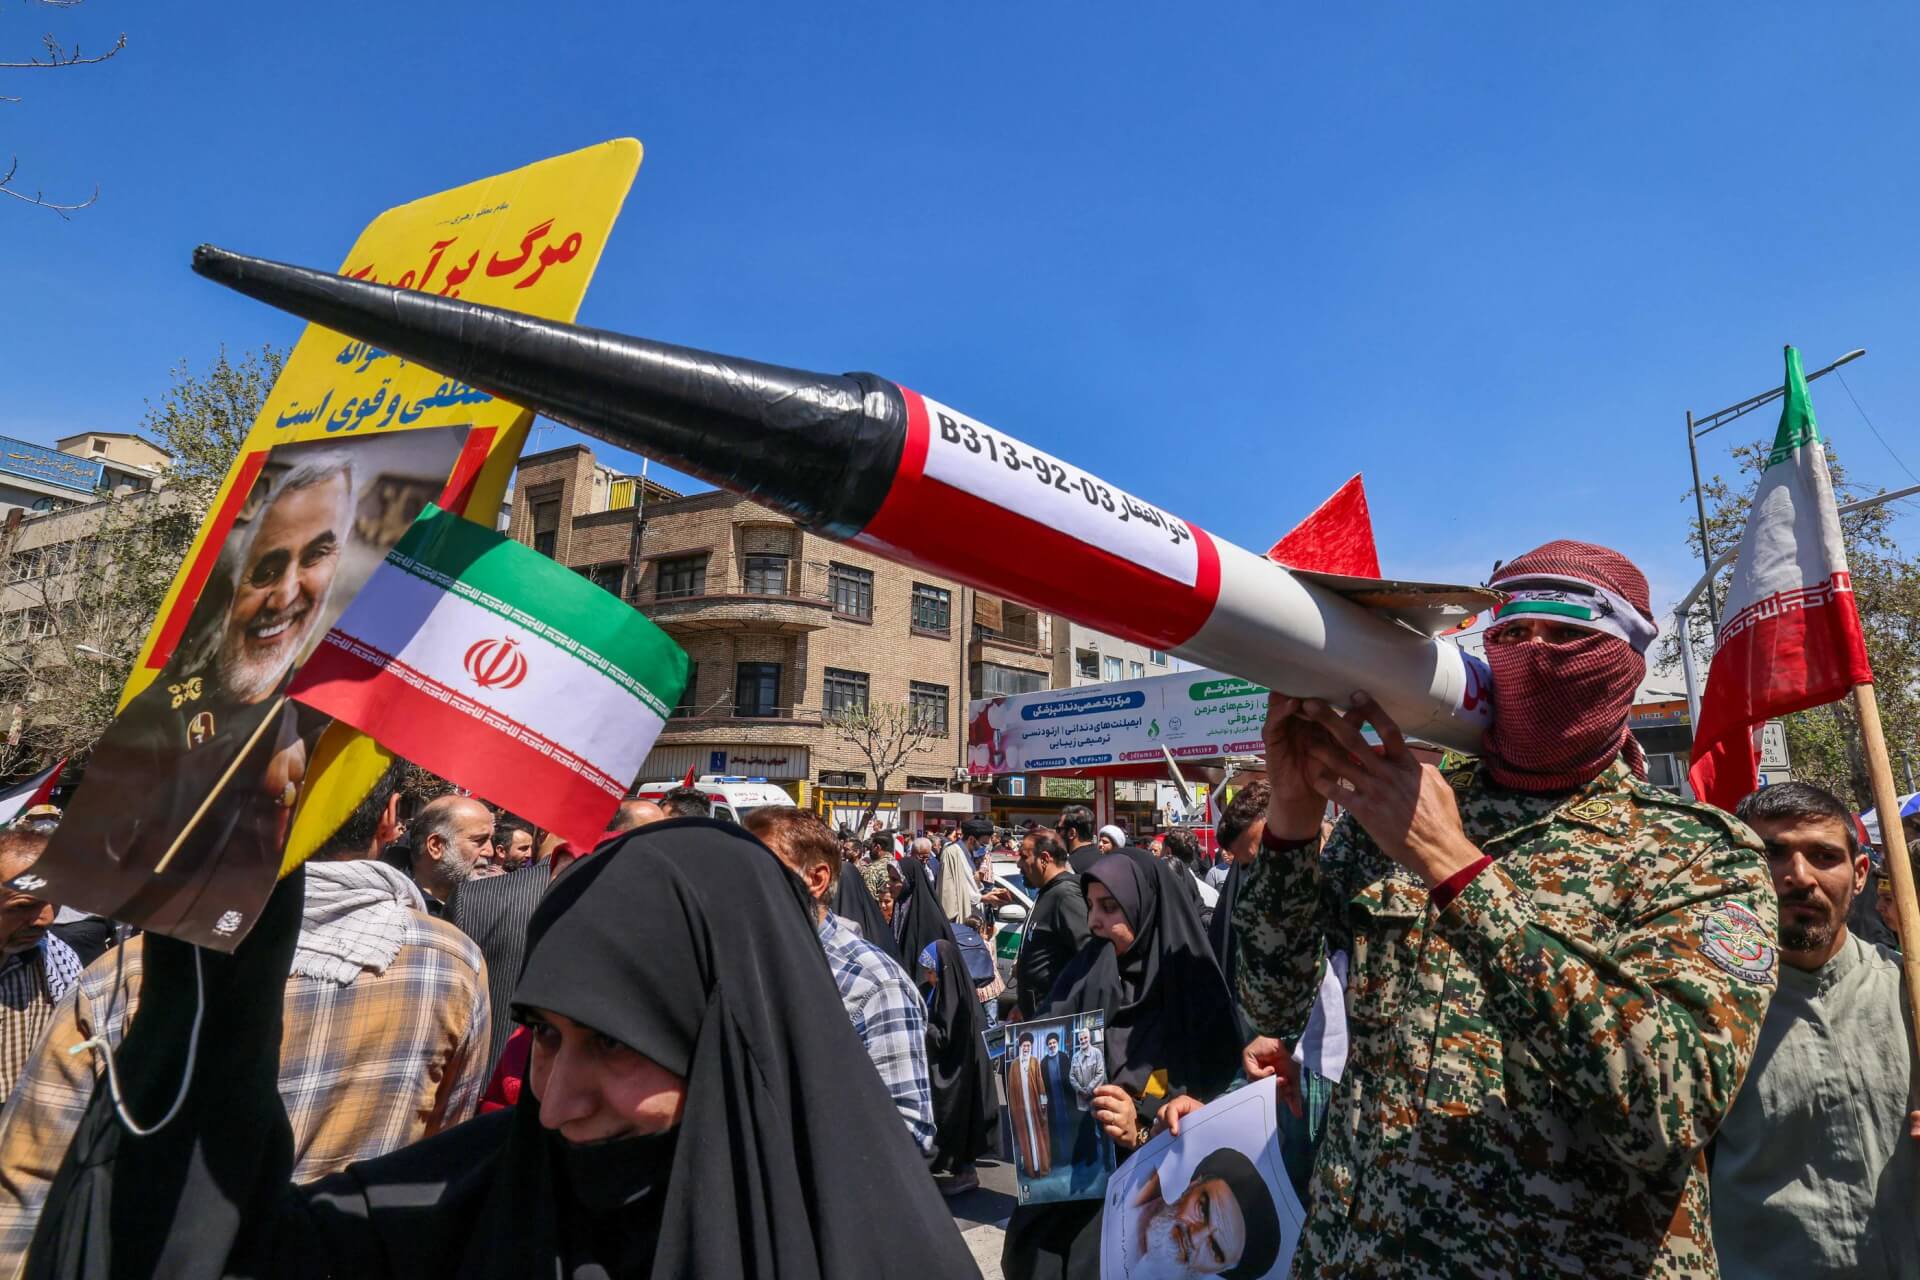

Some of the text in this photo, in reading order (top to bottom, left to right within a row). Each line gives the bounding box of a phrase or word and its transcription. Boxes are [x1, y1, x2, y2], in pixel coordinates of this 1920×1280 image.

[438, 249, 480, 299] بر
[486, 217, 583, 290] مرگ
[275, 388, 335, 429] است
[325, 377, 392, 433] قوی
[375, 393, 402, 428] و
[936, 410, 1116, 513] B313-92-03
[1077, 698, 1111, 713] تخصصی
[1110, 696, 1131, 709] مرکز
[1194, 705, 1218, 717] مزمن
